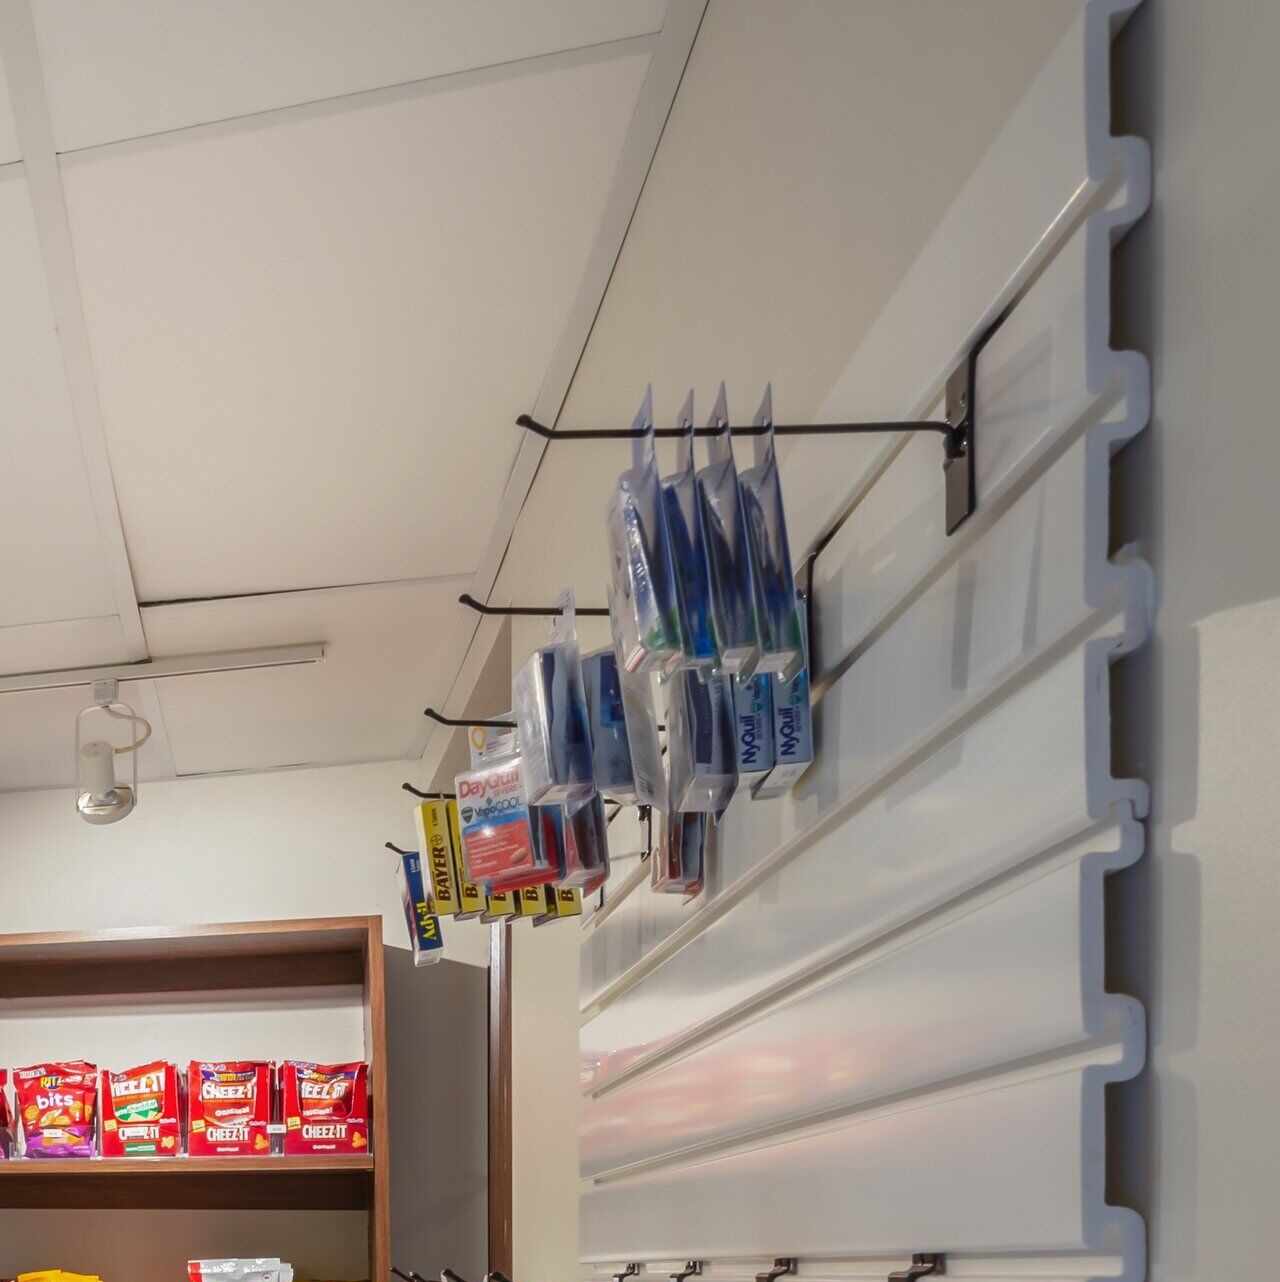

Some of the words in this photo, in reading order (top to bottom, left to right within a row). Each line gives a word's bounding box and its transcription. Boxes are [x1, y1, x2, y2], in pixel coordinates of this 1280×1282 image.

[741, 715, 754, 764] NyQuil
[780, 707, 794, 756] NyQuil
[459, 771, 519, 798] DayQuil
[473, 797, 523, 819] VapoCOOL
[434, 846, 450, 901] BAYER
[416, 900, 437, 942] Advil
[40, 1075, 64, 1088] RITZ
[36, 1092, 74, 1110] bits
